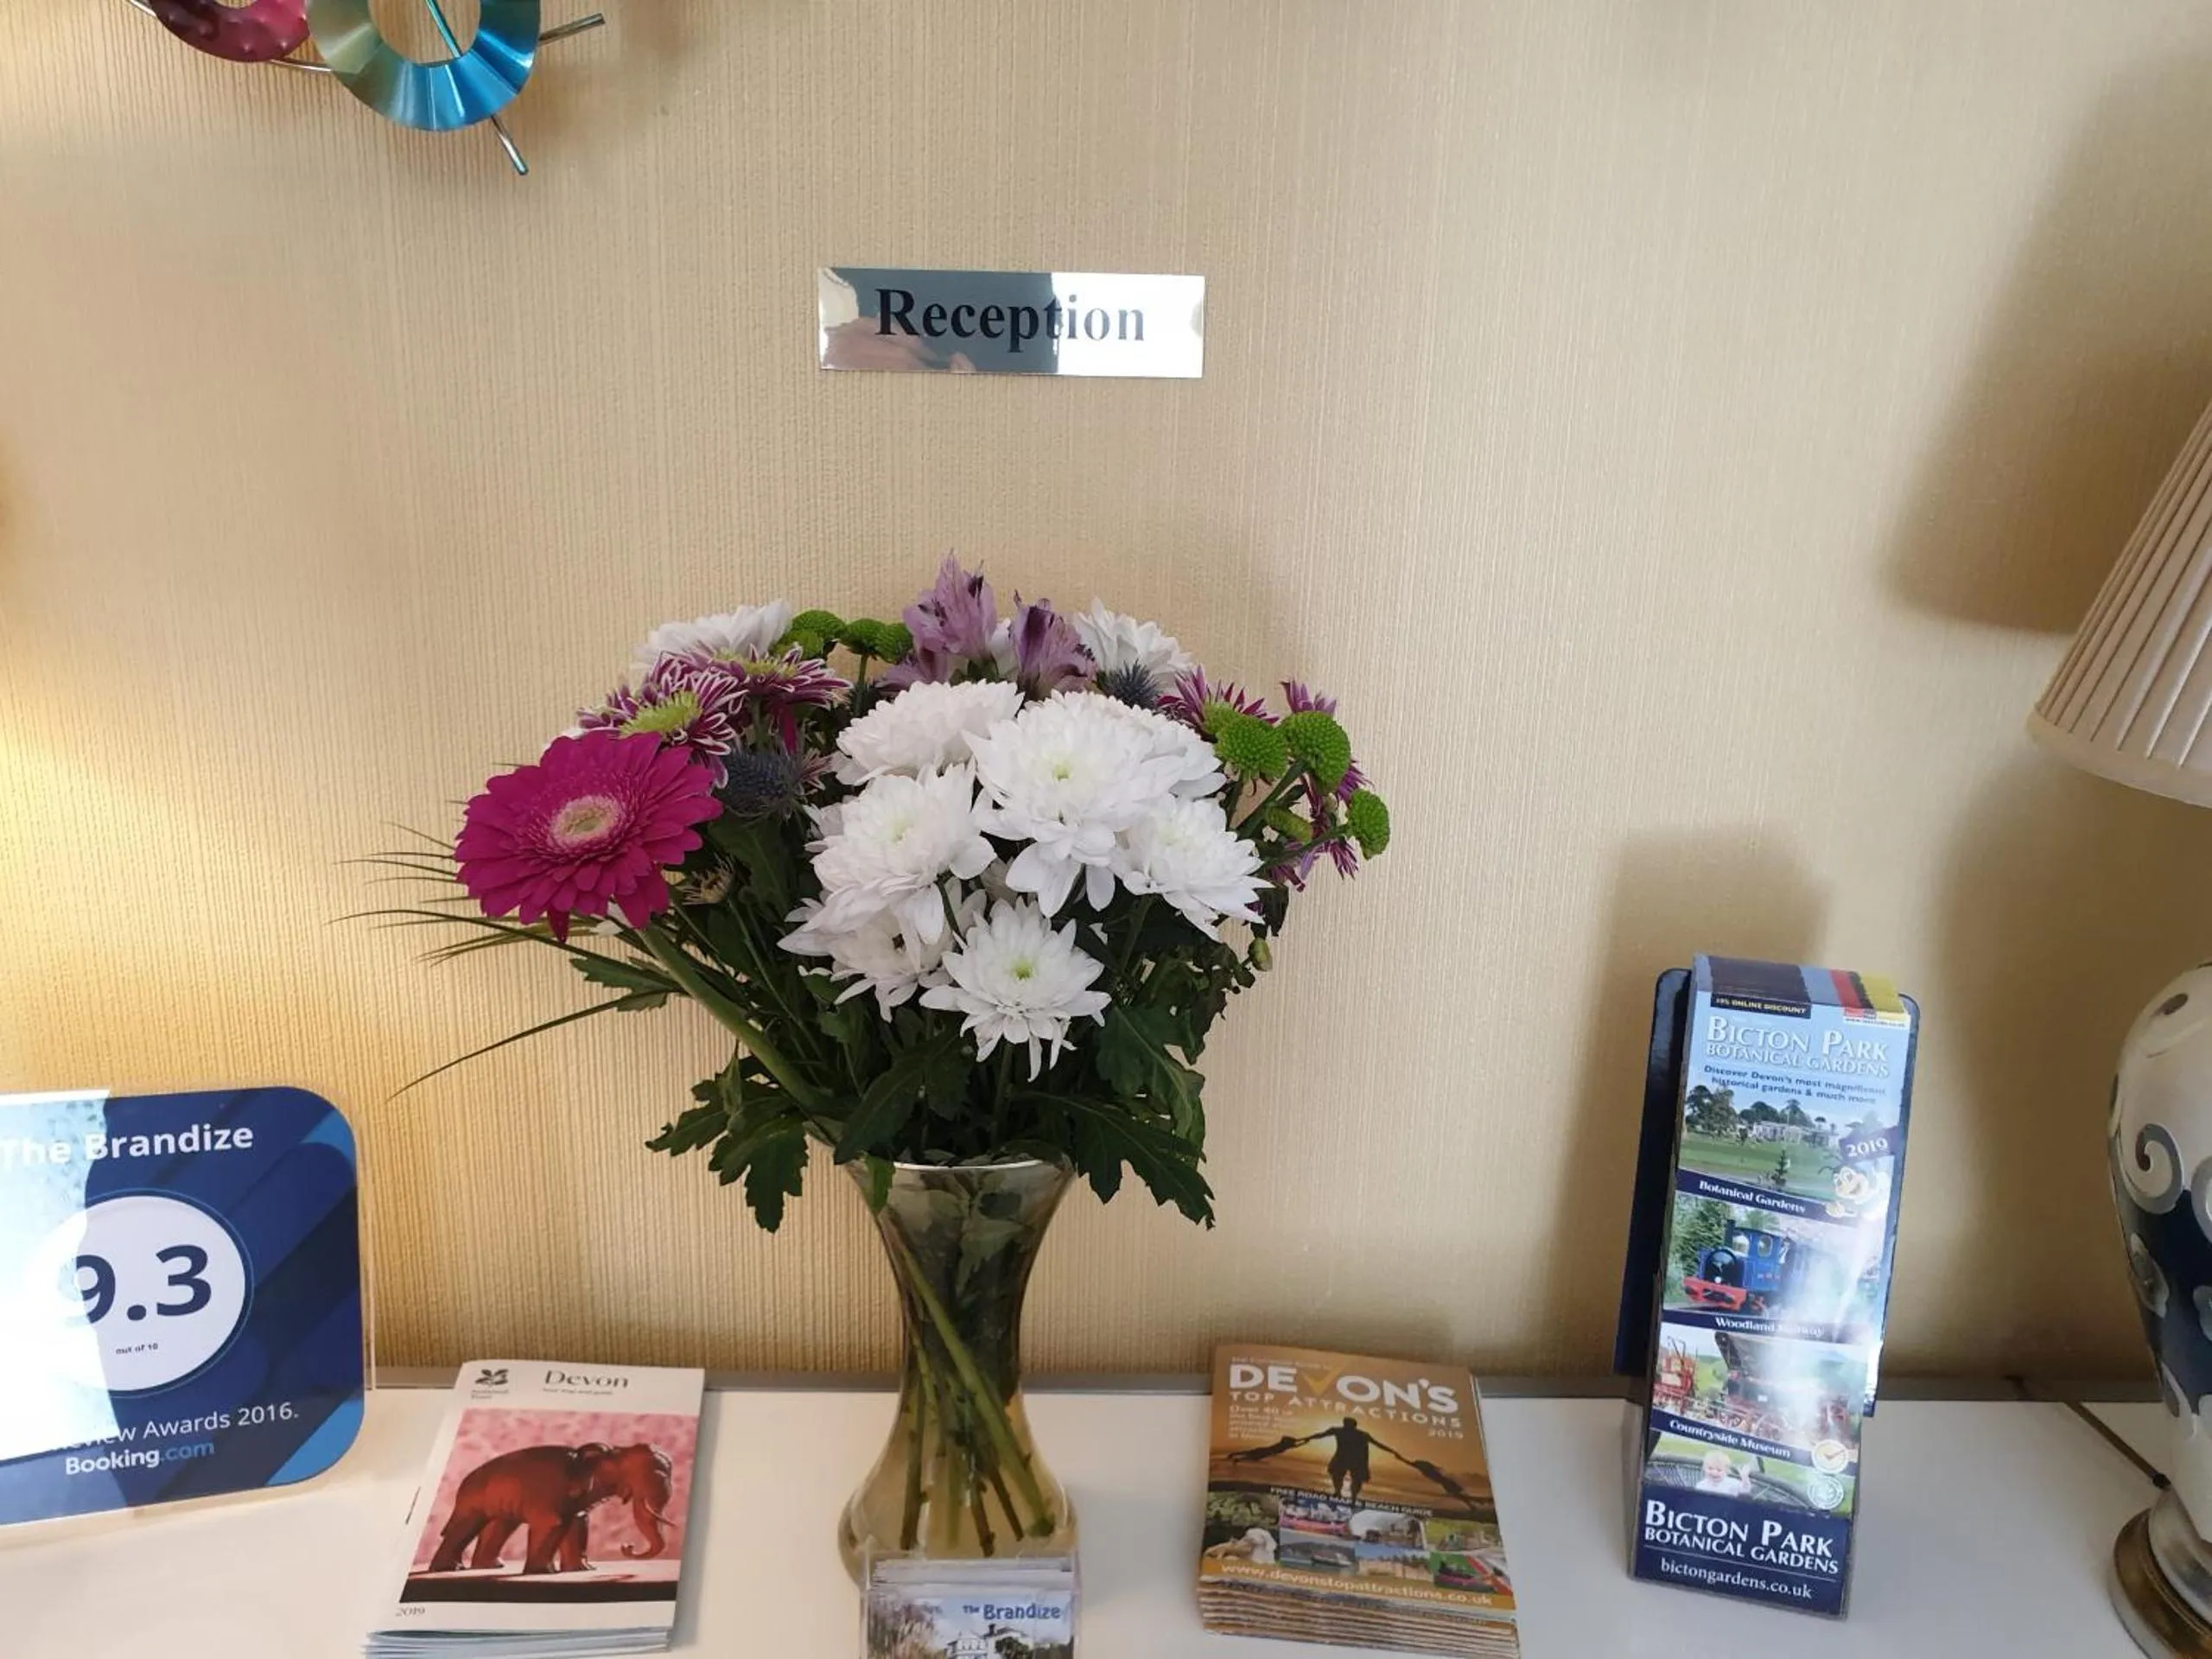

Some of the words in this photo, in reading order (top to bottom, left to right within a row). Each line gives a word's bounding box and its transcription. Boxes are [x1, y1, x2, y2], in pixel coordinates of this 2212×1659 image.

[874, 288, 1145, 353] Reception
[1732, 1000, 1763, 1009] ONLINE
[1764, 1003, 1805, 1014] DISCOUNT
[1704, 1065, 1748, 1077] Discover
[1751, 1071, 1792, 1084] Devon's
[1796, 1078, 1821, 1088] most
[1706, 1044, 1802, 1068] BOTANICAL
[1807, 1057, 1890, 1077] GARDENS
[1712, 1077, 1758, 1090] historical
[1762, 1083, 1802, 1096] gardens
[1816, 1090, 1845, 1102] much
[0, 1136, 73, 1164] The
[85, 1123, 254, 1161] Brandize
[1845, 1137, 1888, 1158] 2019
[1699, 1180, 1753, 1201] Botanical
[1756, 1193, 1806, 1214] Gardens
[57, 1244, 212, 1326] 9.3
[1715, 1317, 1775, 1332] Woodland
[116, 1346, 132, 1355] out
[135, 1343, 146, 1352] of
[148, 1343, 159, 1351] 10
[545, 1370, 629, 1389] Devon
[143, 1411, 231, 1440] Awards
[237, 1402, 299, 1426] 2016.
[1230, 1391, 1274, 1402] TOP
[1288, 1395, 1462, 1428] ATTRACTIONS
[1669, 1419, 1738, 1446] Countryside
[1739, 1438, 1790, 1459] Museum
[65, 1440, 214, 1476] Booking.com
[1270, 1487, 1295, 1497] FREE
[1297, 1491, 1328, 1501] ROAD
[1329, 1496, 1352, 1504] MAP
[1364, 1501, 1400, 1510] BEACH
[1401, 1506, 1433, 1516] GUIDE
[1645, 1499, 1749, 1542] BICTON
[1761, 1520, 1834, 1558] PARK
[1644, 1528, 1745, 1558] BOTANICAL
[1751, 1546, 1839, 1574] GARDENS
[1221, 1563, 1492, 1605] www.devonstopattractions.co.uk
[1661, 1557, 1813, 1599] bictongardens.co.uk
[983, 1603, 1061, 1620] Brandize
